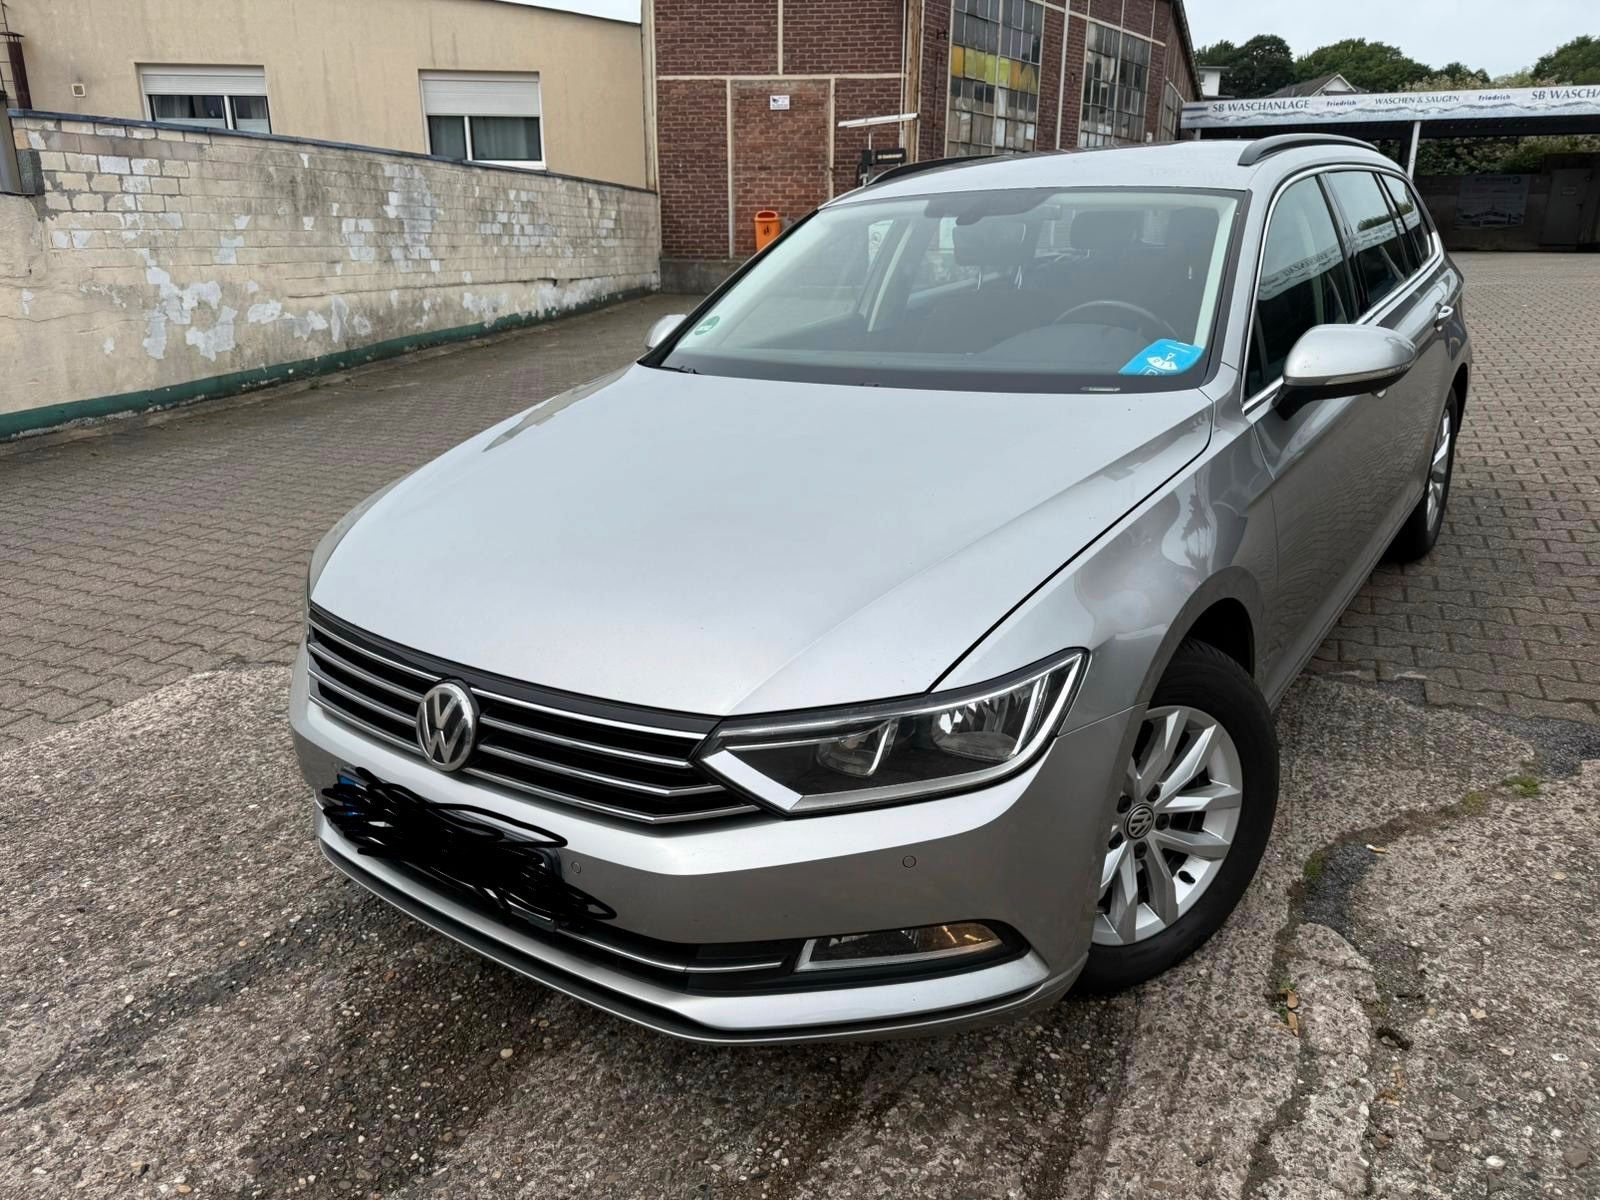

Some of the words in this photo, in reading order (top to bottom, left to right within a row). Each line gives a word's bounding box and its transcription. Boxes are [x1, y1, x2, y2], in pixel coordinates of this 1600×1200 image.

[1375, 96, 1415, 105] WASCHEN
[1531, 90, 1546, 100] SB
[1212, 102, 1225, 113] SB
[1227, 100, 1310, 113] WASCHANLAGE
[418, 684, 472, 770] VW
